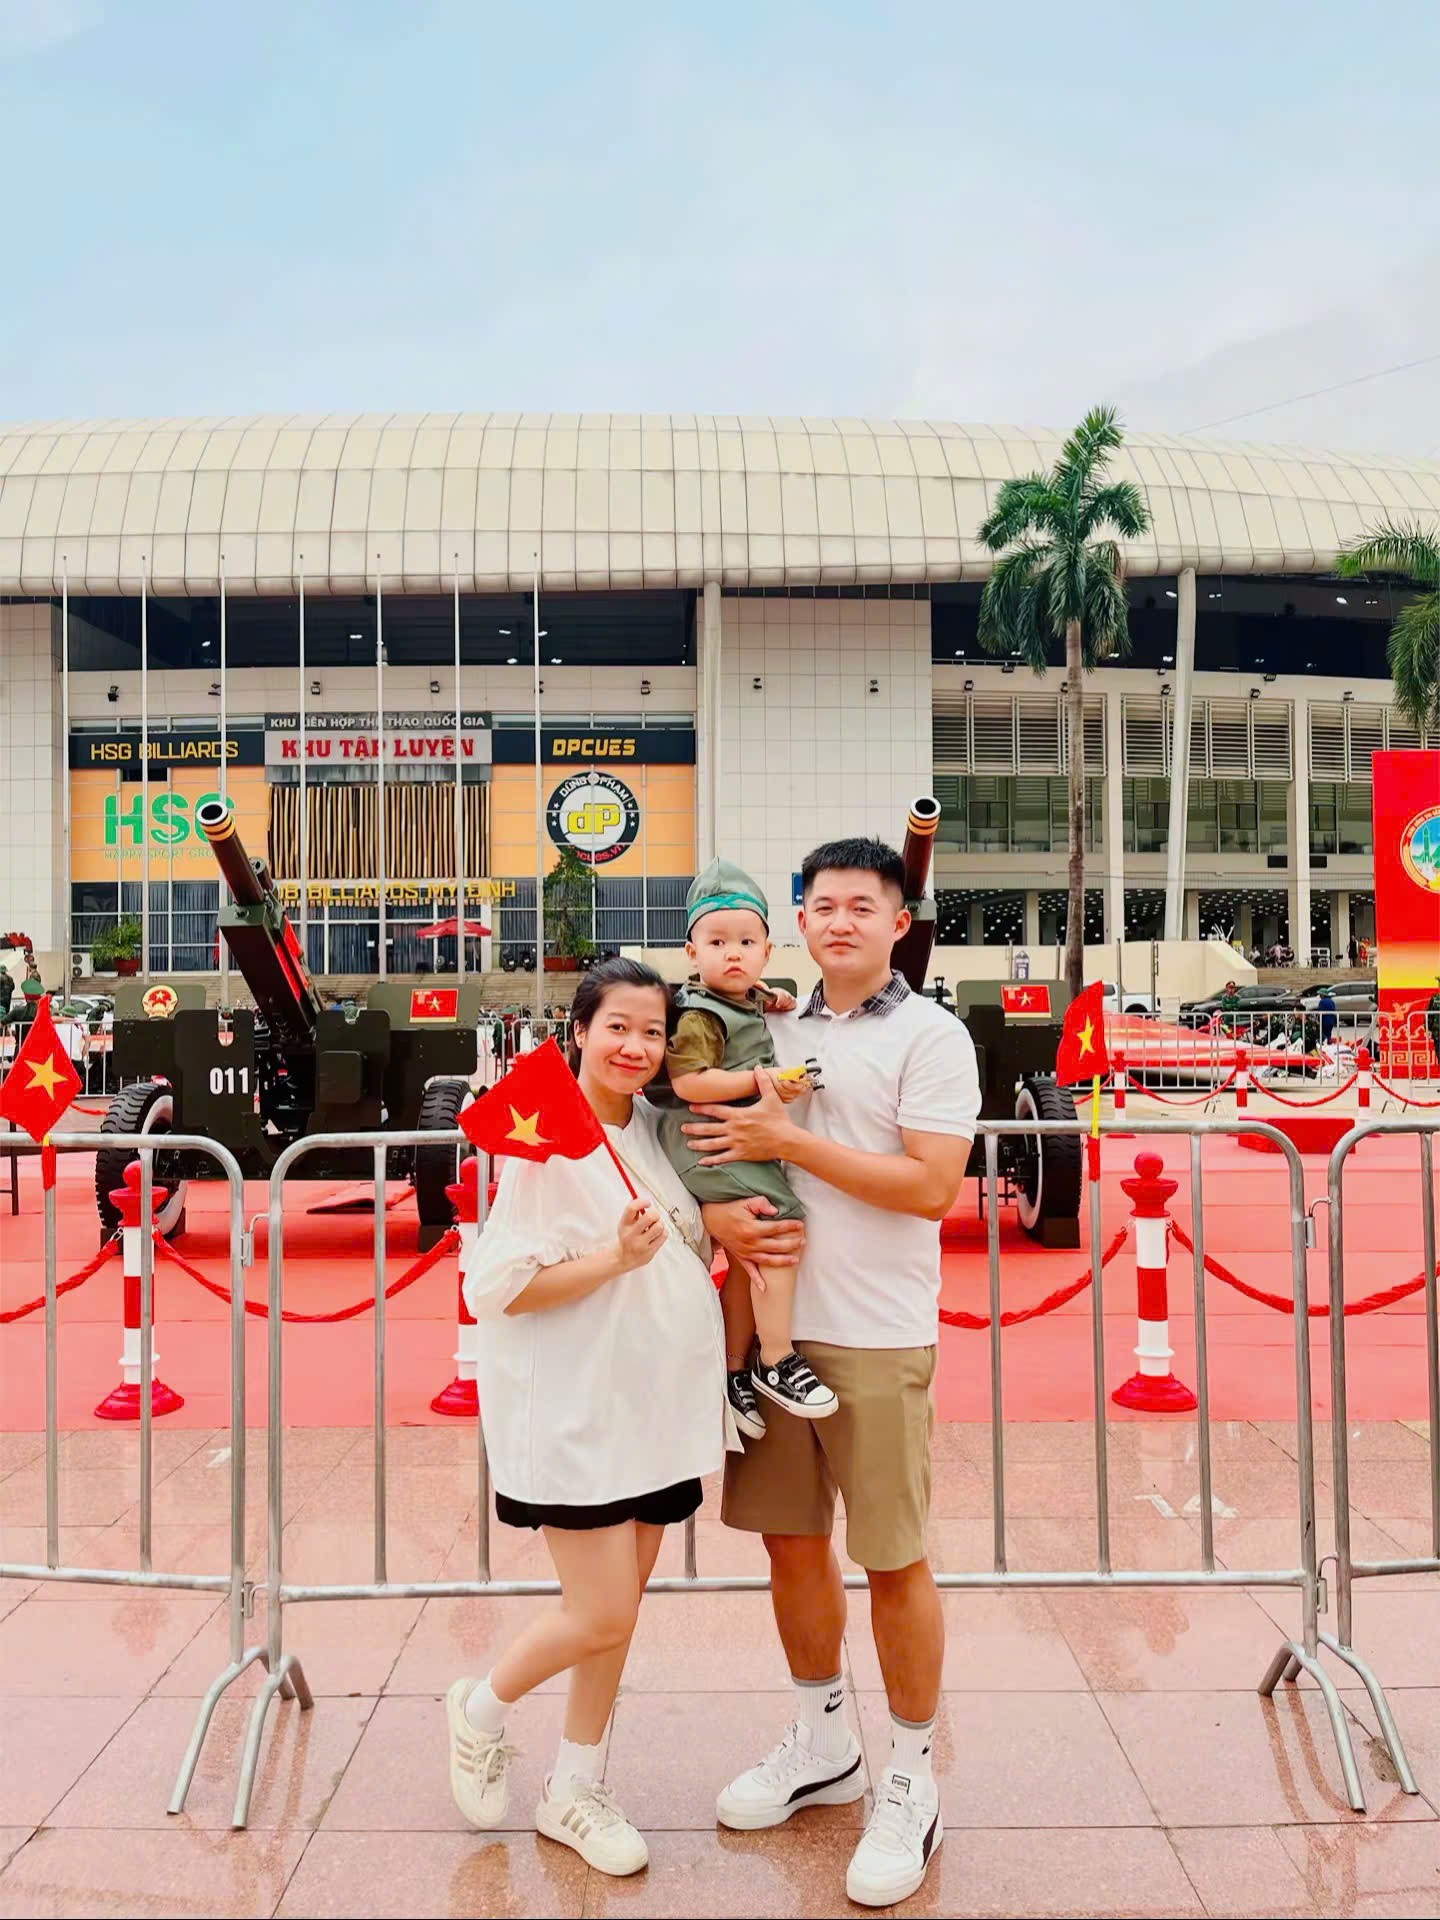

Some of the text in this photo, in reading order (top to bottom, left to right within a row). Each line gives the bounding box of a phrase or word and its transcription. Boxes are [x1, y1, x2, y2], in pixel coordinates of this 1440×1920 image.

[270, 717, 296, 728] KHU
[304, 715, 327, 728] IÊN
[330, 716, 355, 730] HỢP
[462, 716, 485, 728] GIA
[90, 740, 239, 760] HSG BILLIARDS
[281, 735, 474, 761] KHU TẬP LUYỆN
[552, 738, 636, 756] DPCUES
[308, 881, 419, 900] BILLIARDS
[209, 1067, 249, 1095] 011
